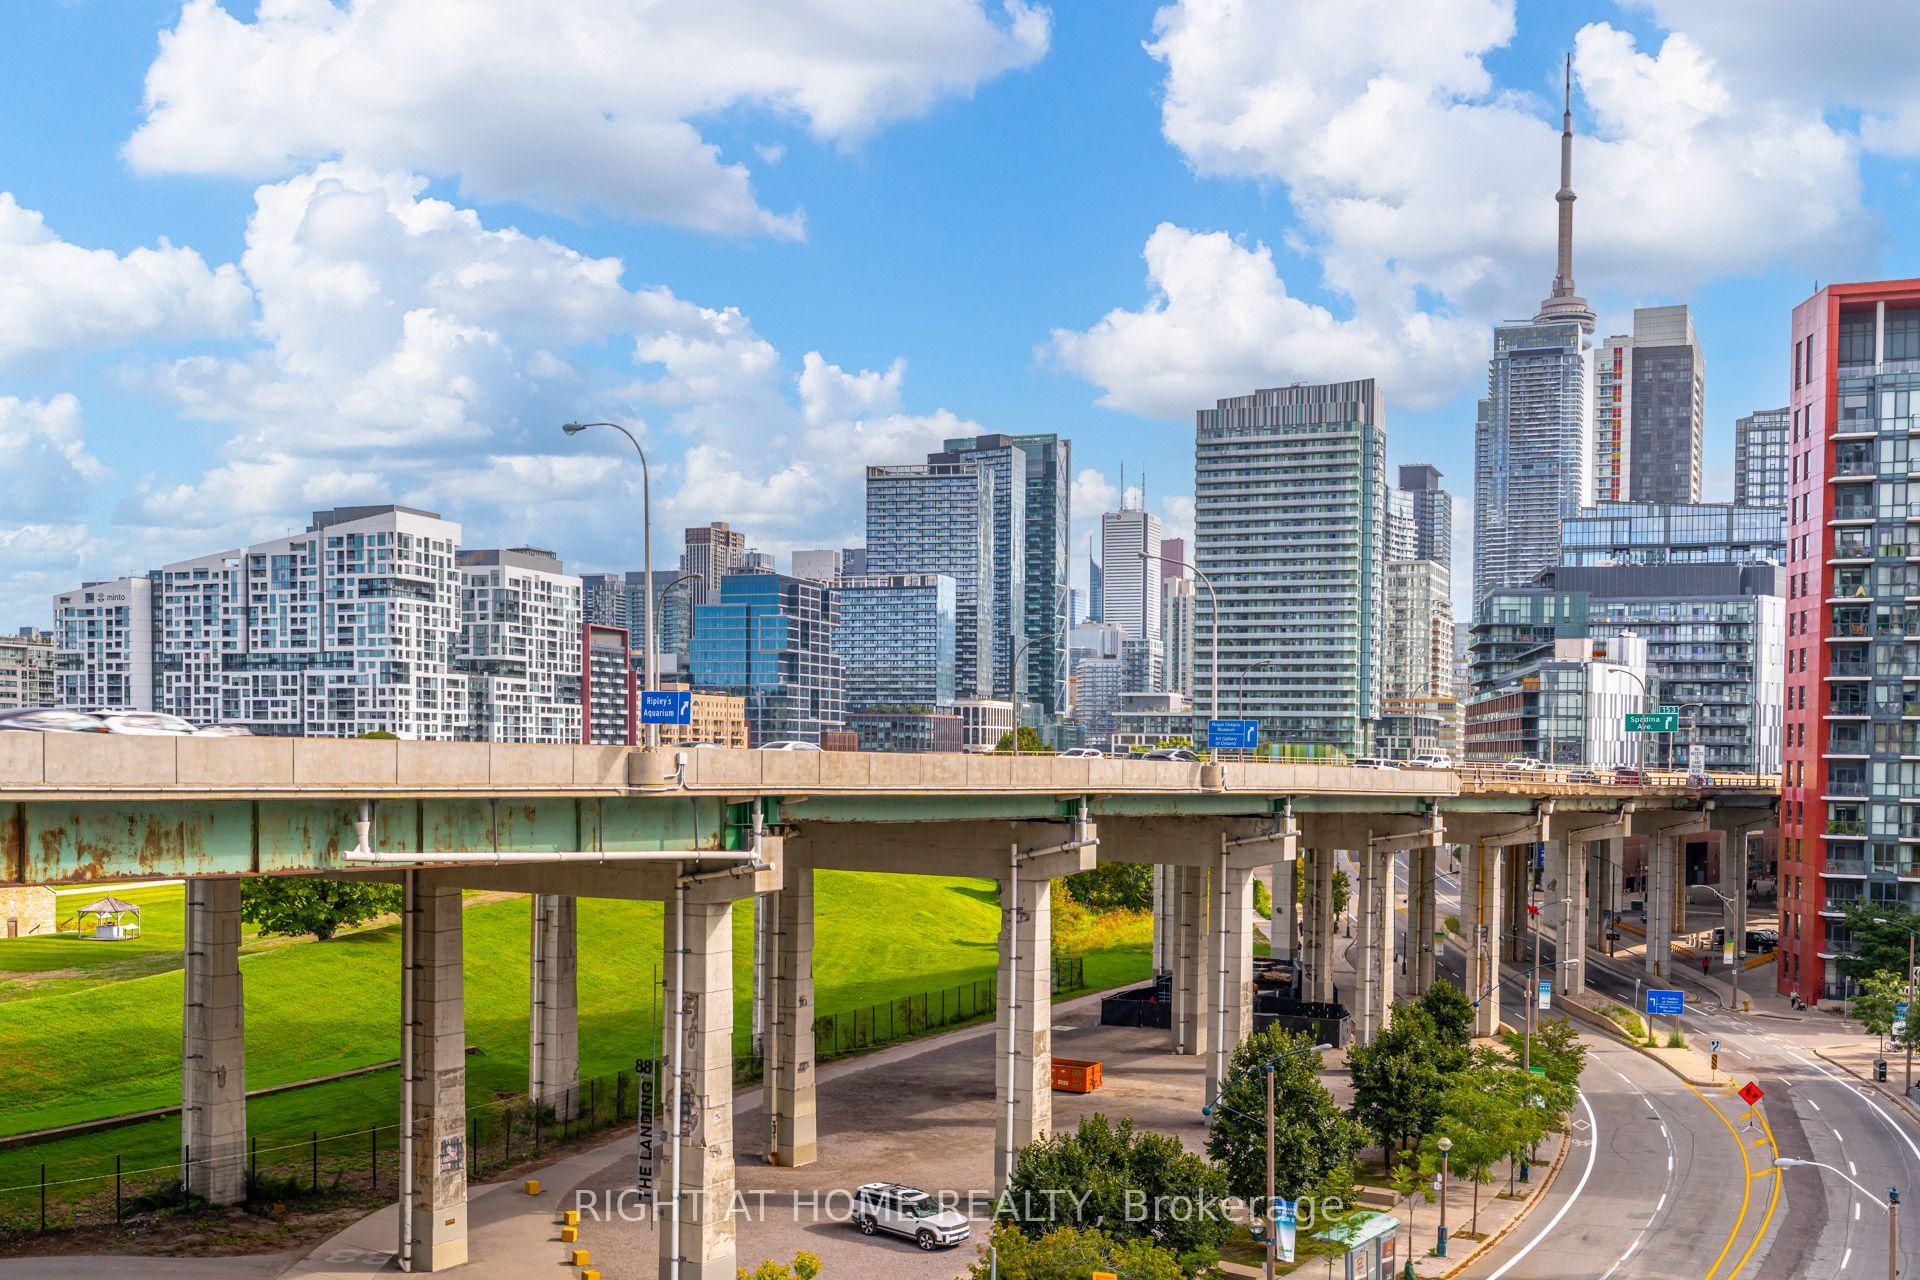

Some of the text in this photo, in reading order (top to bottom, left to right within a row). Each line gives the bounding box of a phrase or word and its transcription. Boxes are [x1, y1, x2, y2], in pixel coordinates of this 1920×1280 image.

[106, 593, 126, 601] minto
[646, 695, 672, 706] Ripley's
[643, 708, 675, 719] Aquarium
[635, 1058, 651, 1075] 88
[638, 1081, 653, 1201] THE LANDING
